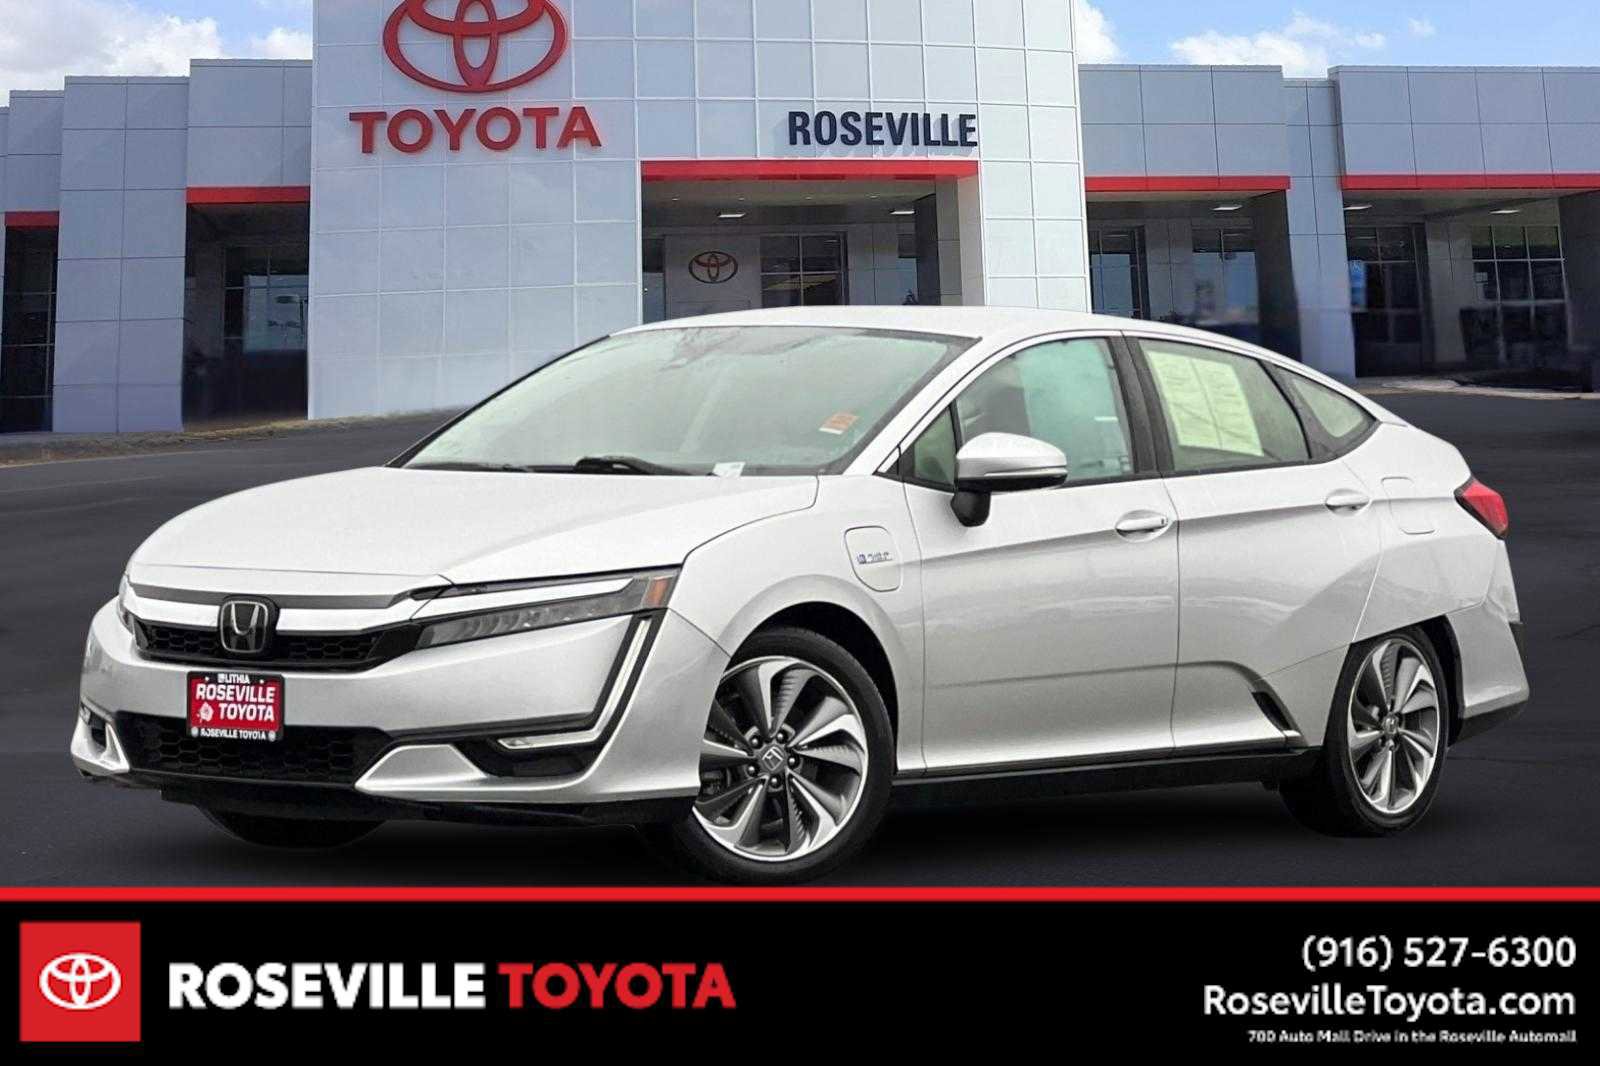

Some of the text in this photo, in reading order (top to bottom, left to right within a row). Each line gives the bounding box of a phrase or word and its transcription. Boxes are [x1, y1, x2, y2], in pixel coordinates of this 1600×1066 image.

[349, 106, 602, 154] TOYOTA
[788, 111, 978, 147] ROSEVILLE
[195, 683, 276, 703] ROSEVILLE
[218, 702, 275, 722] TOYOTA
[200, 727, 267, 740] ROSEVILLE TOYOTA
